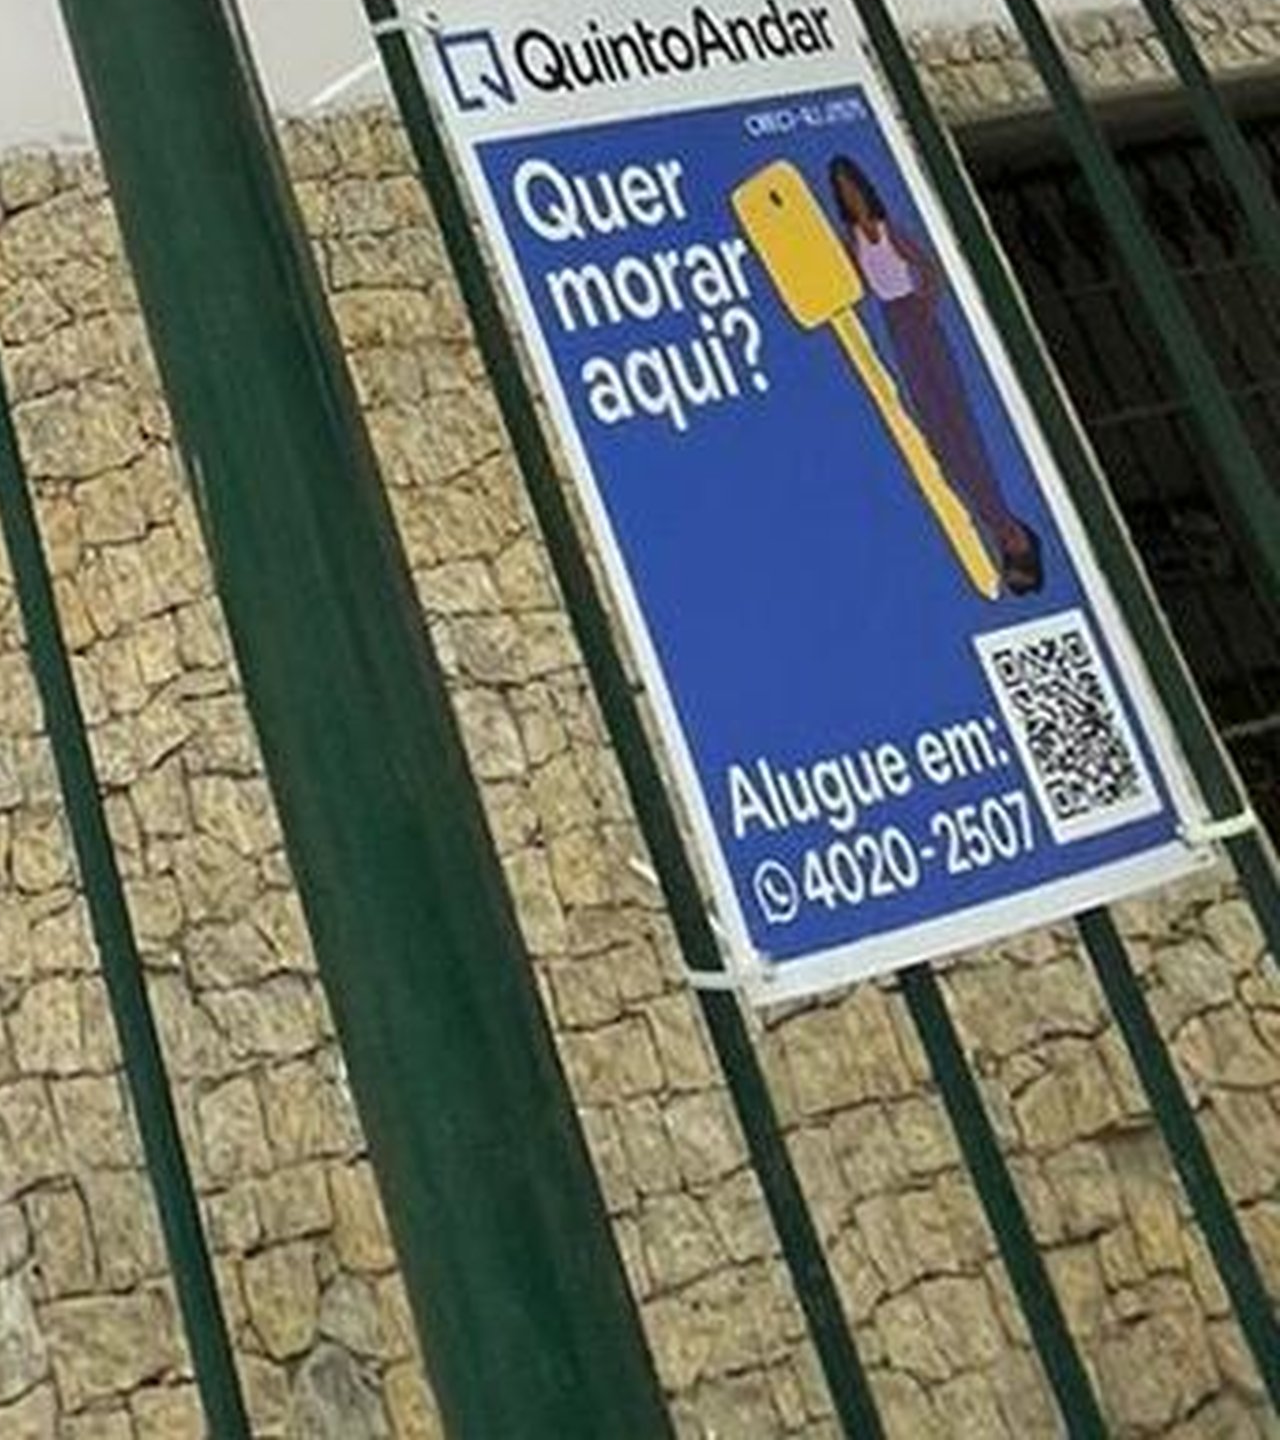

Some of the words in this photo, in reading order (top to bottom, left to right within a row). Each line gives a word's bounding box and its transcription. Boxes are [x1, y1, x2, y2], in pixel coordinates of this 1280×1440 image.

[513, 0, 835, 93] QuintoAndar
[513, 158, 689, 242] Quer
[546, 237, 751, 332] morar
[580, 307, 769, 432] aqui?
[728, 743, 912, 839] Alugue
[917, 716, 1010, 784] em:
[803, 791, 1035, 910] 4020-2507
